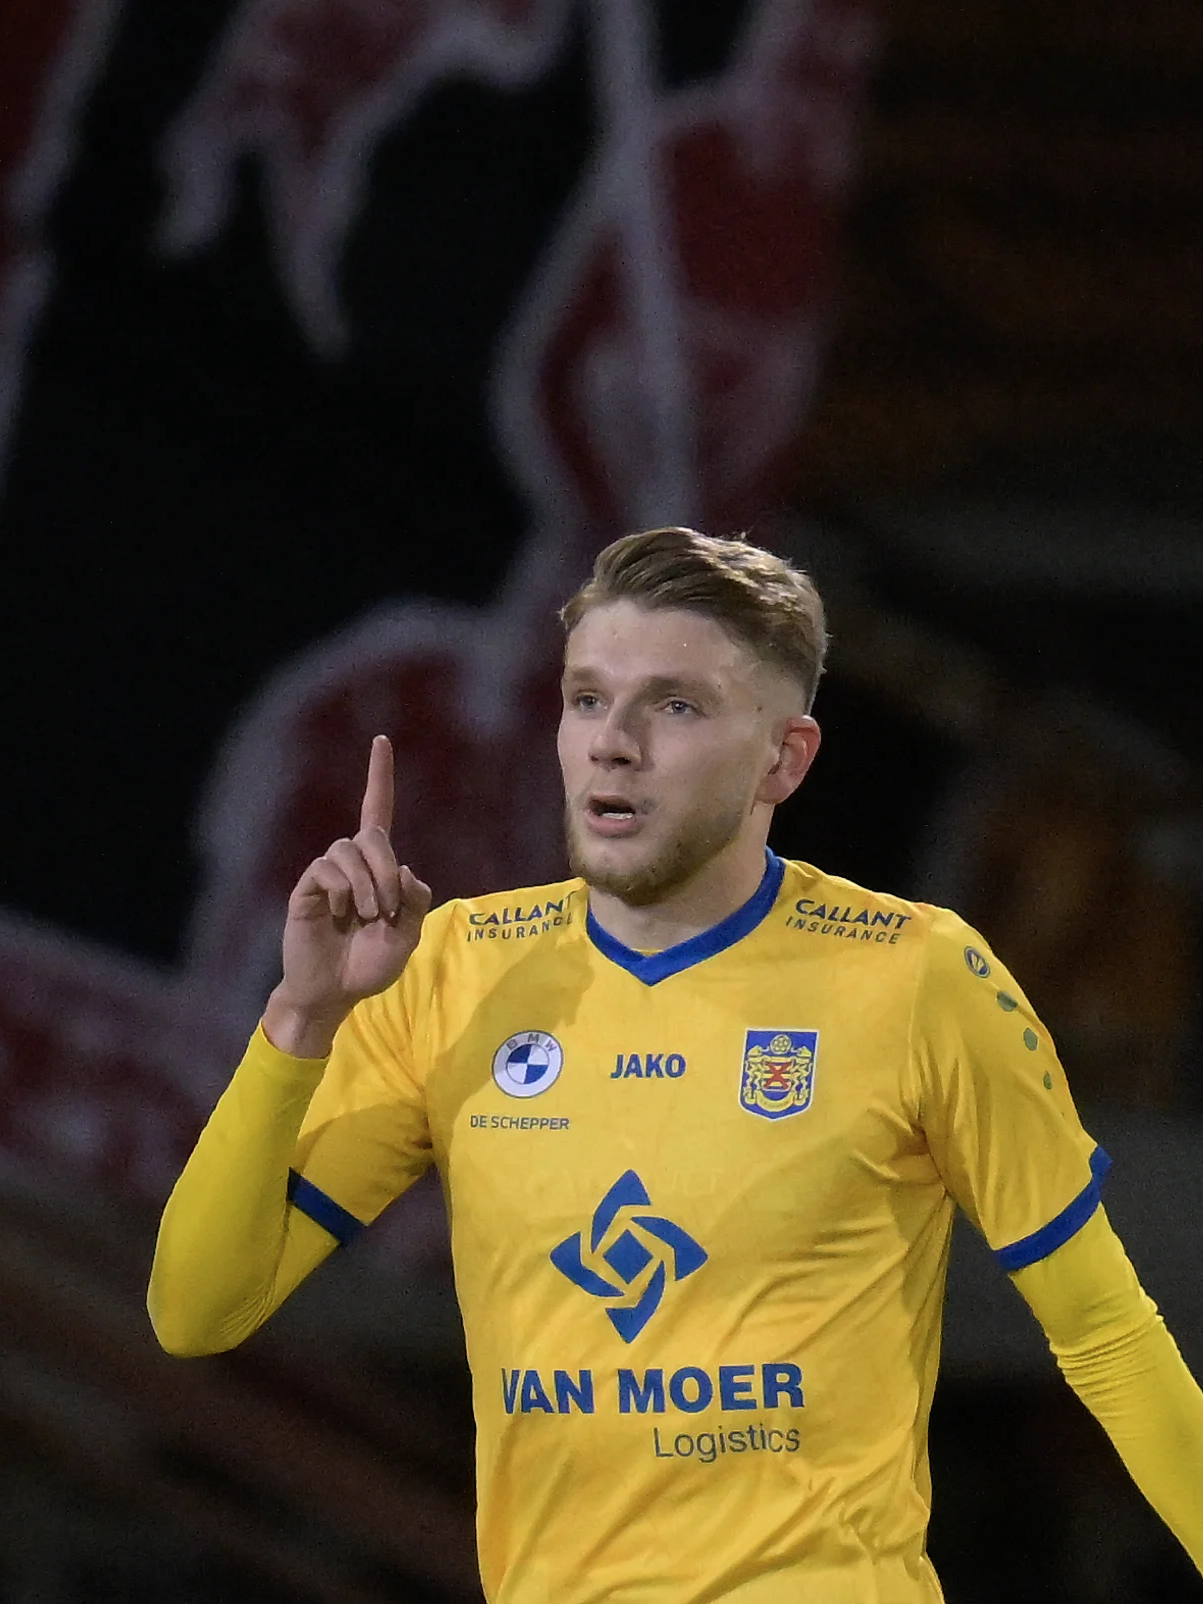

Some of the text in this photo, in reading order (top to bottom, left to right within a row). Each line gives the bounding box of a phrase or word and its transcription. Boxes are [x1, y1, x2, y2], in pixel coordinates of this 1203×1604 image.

[469, 890, 577, 926] CALLANT
[795, 898, 912, 930] CALLANT
[785, 915, 901, 945] INSURANCE
[610, 1053, 686, 1079] JAKO
[470, 1115, 570, 1130] DE SCHEPPER
[501, 1363, 805, 1414] VAN MOER
[653, 1422, 800, 1463] Logistics
